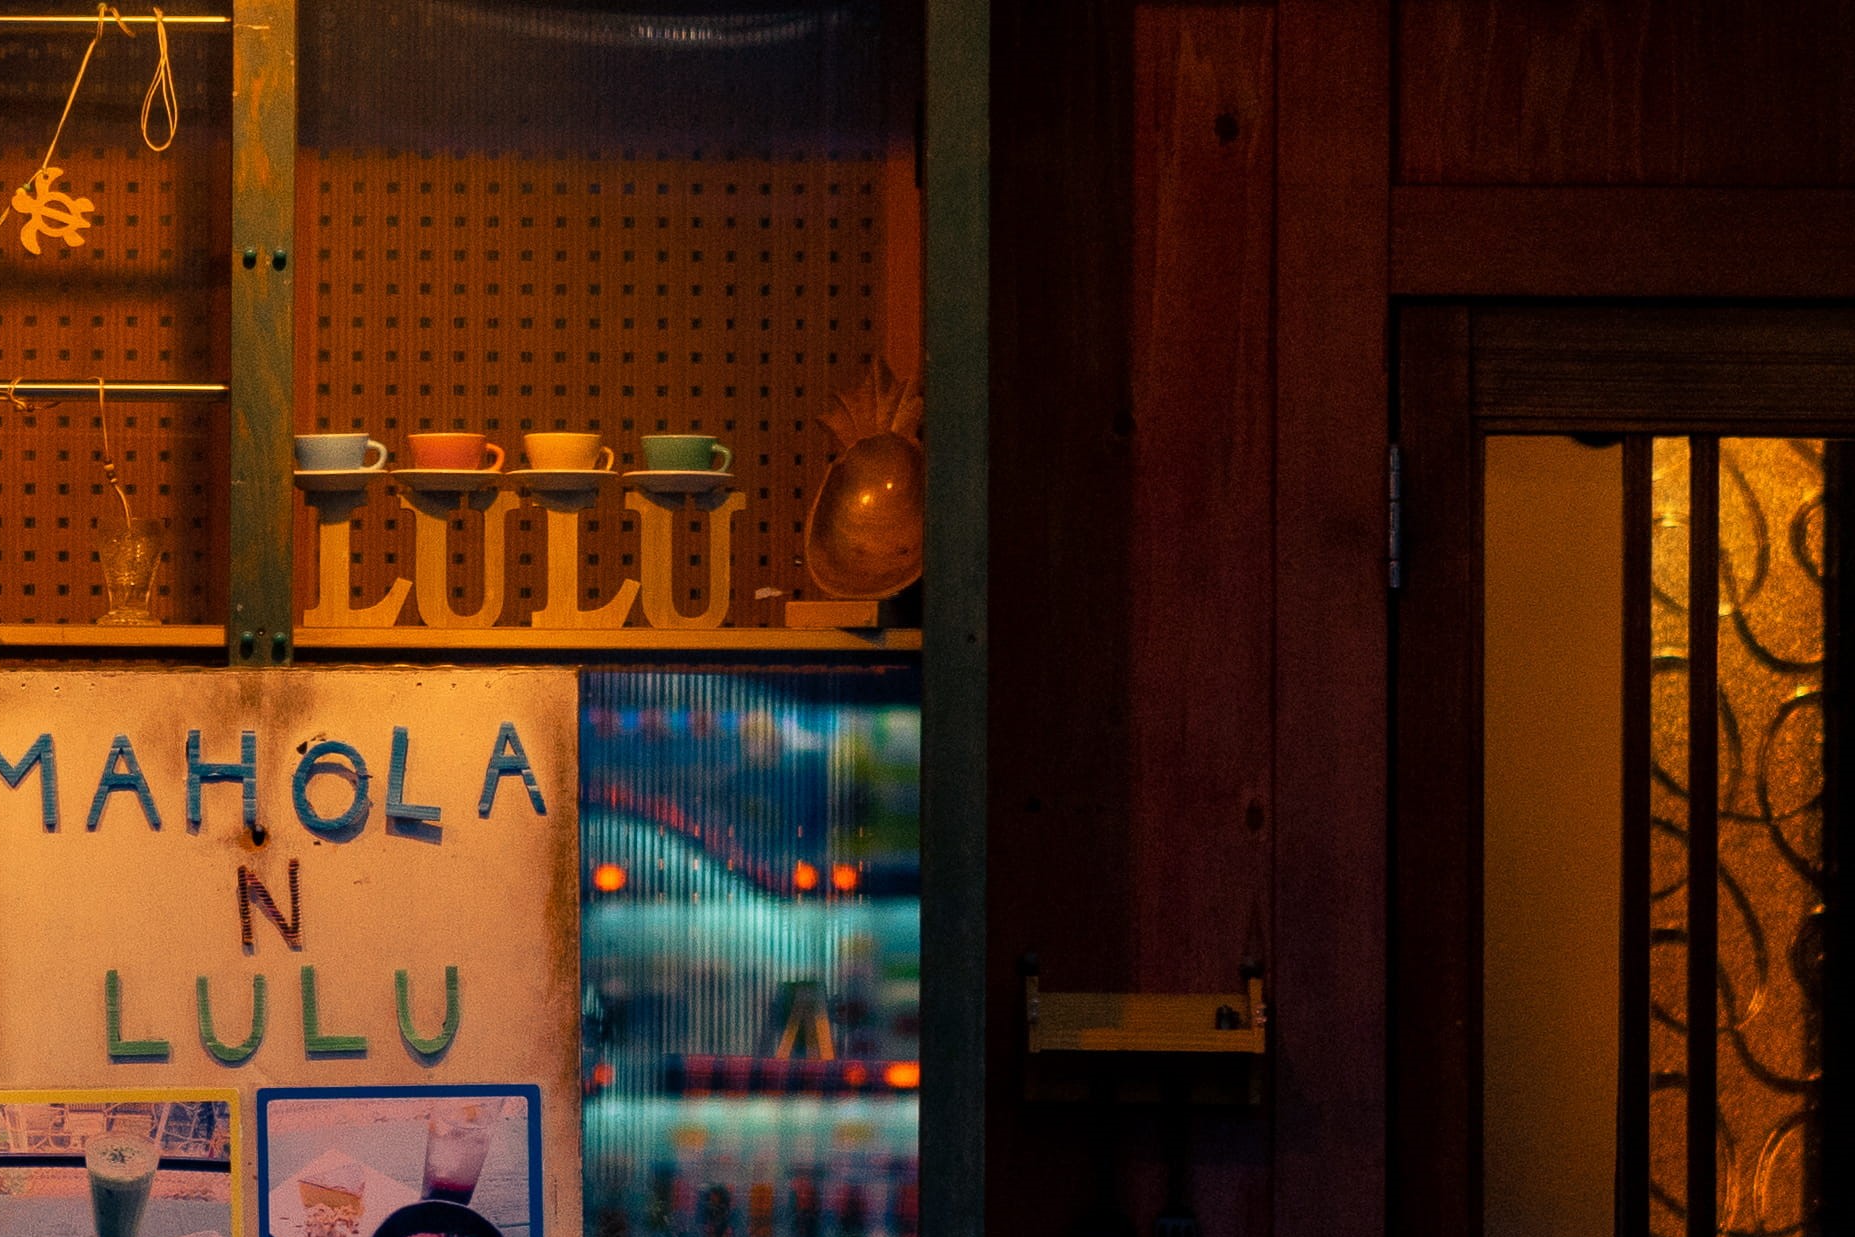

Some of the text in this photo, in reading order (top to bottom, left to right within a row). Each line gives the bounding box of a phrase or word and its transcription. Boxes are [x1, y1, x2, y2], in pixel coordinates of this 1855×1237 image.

[294, 488, 743, 628] LULU
[237, 857, 303, 951] N
[106, 963, 461, 1067] LULU
